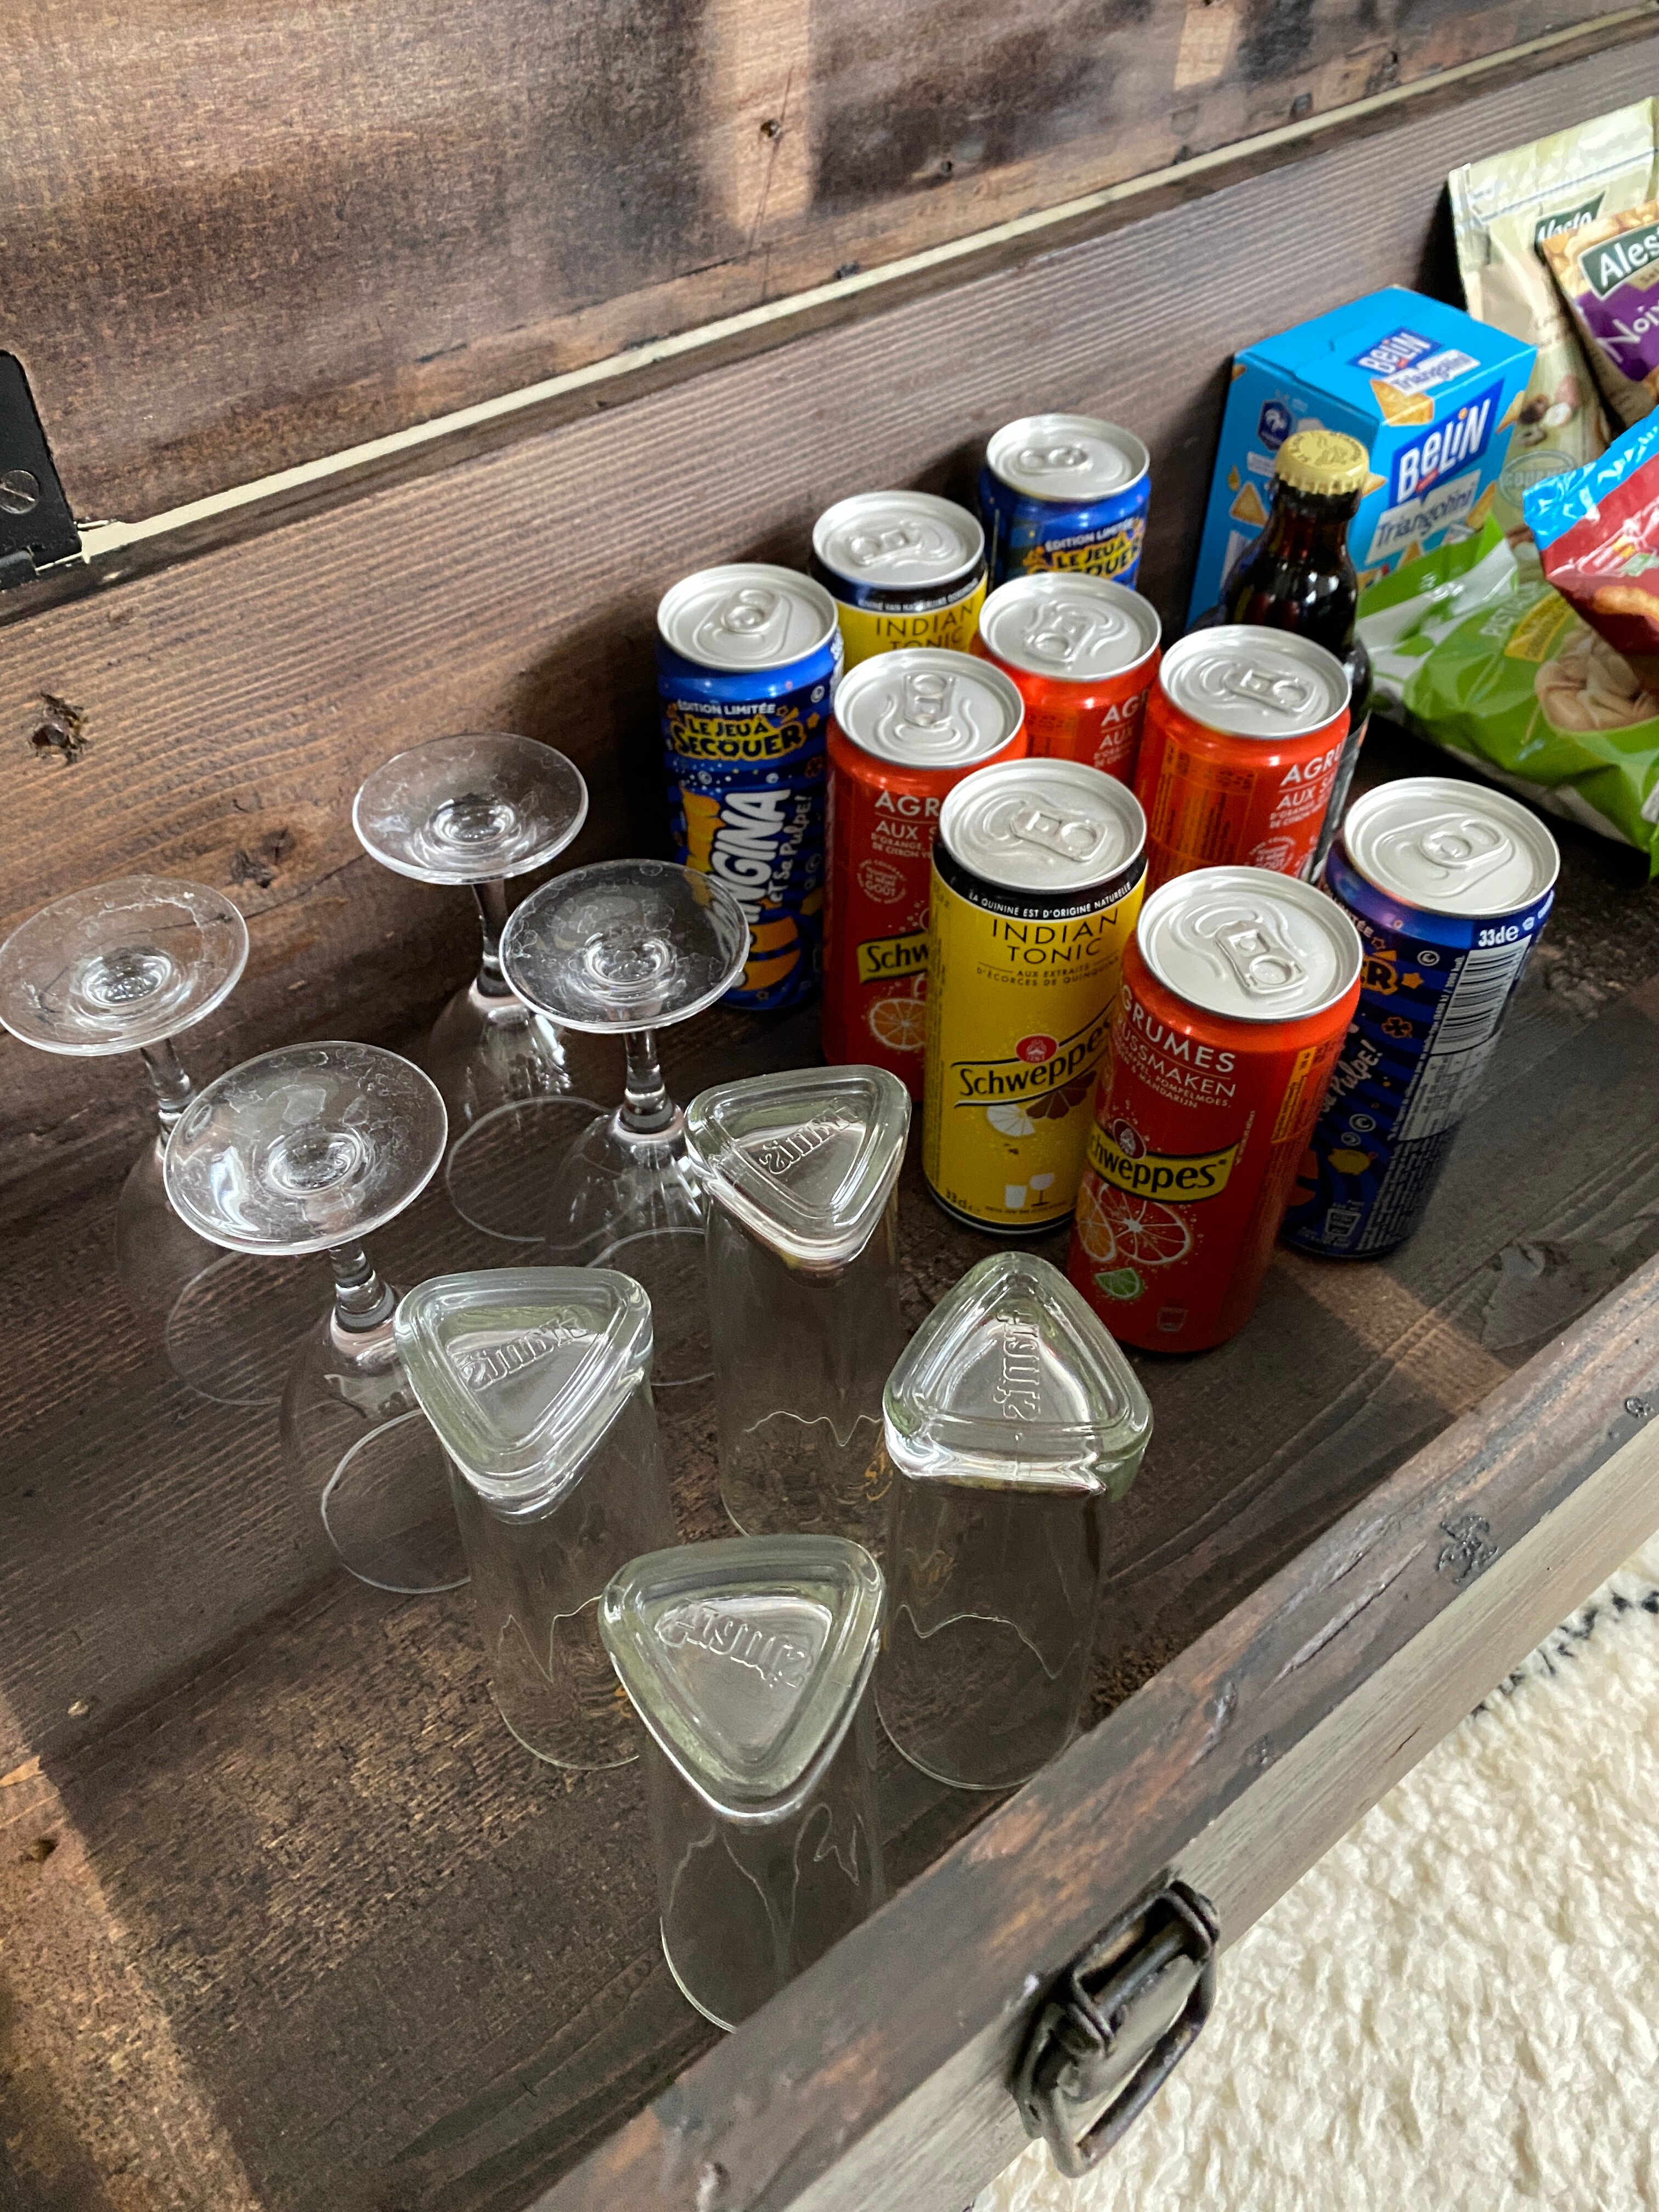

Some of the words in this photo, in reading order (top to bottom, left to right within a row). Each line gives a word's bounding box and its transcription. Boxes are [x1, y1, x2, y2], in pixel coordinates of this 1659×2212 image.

[1600, 227, 1659, 287] Ales
[876, 597, 974, 639] INDIAN
[673, 723, 802, 757] SECOUER
[689, 718, 711, 735] LE
[716, 721, 751, 737] JEU
[1276, 785, 1317, 811] AUX
[876, 820, 919, 840] AUX
[980, 897, 1020, 917] QUININE
[1023, 908, 1039, 918] EST
[1042, 903, 1092, 919] D'ORIGINE
[1094, 881, 1132, 909] NATURELLE
[992, 907, 1119, 944] INDIAN
[1007, 937, 1102, 964] TONIC
[1121, 985, 1235, 1073] GRUMES
[1120, 1015, 1237, 1098] USSMAKEN
[1096, 1141, 1218, 1193] hweppes
